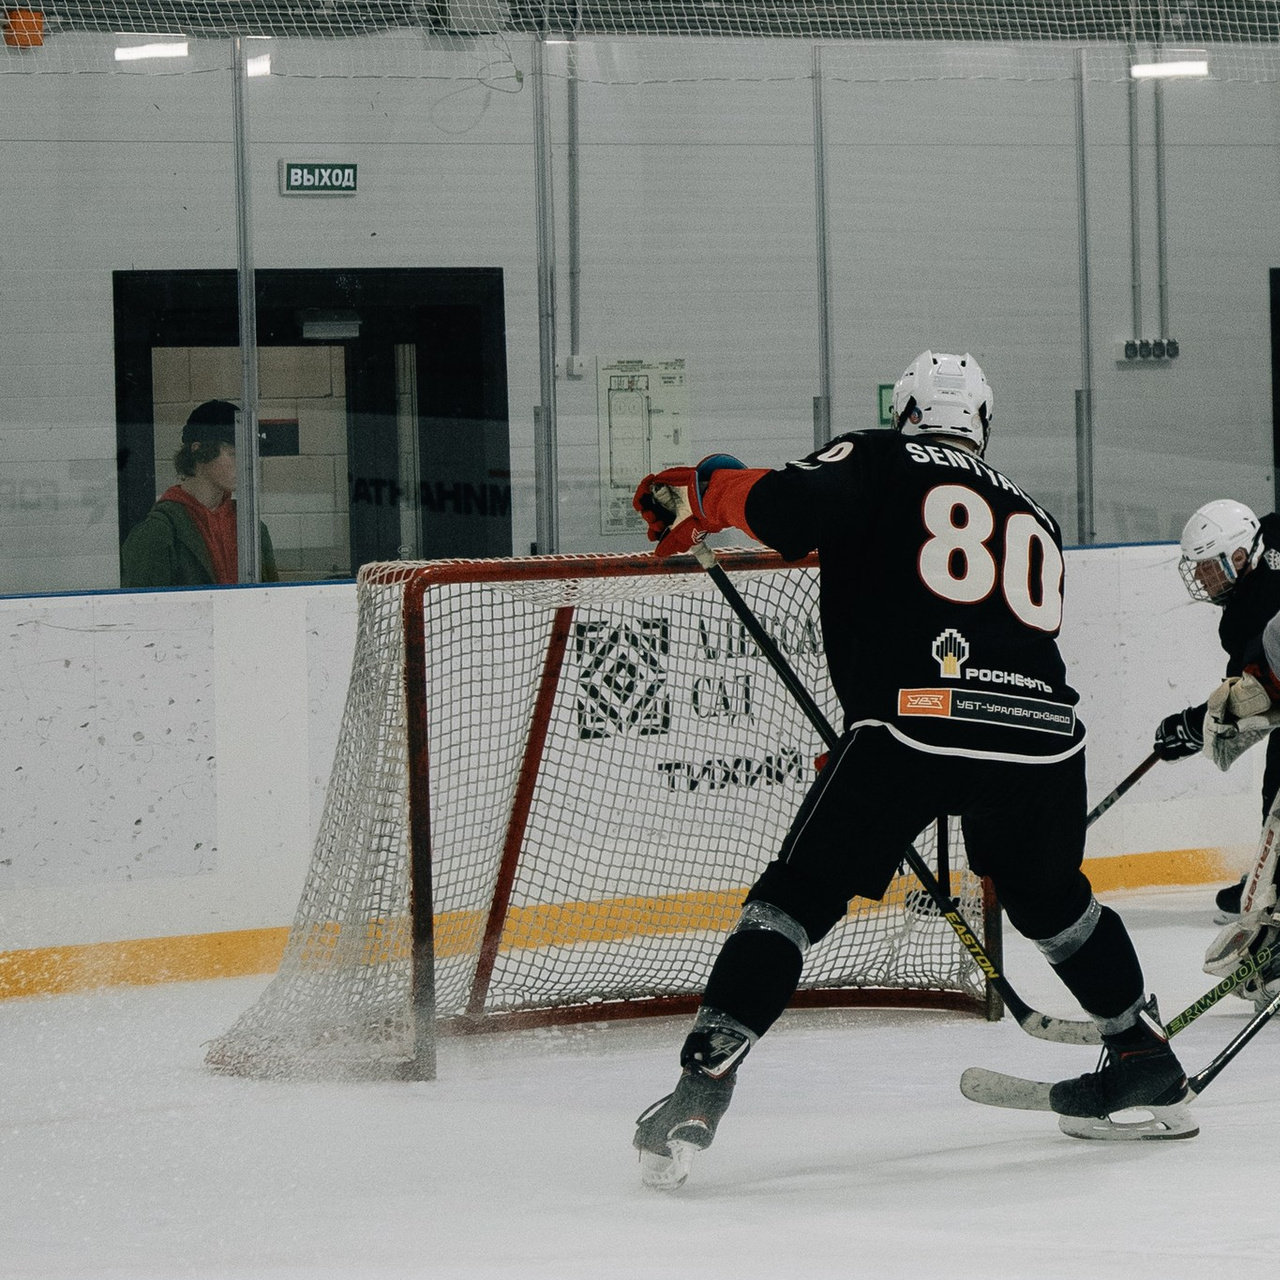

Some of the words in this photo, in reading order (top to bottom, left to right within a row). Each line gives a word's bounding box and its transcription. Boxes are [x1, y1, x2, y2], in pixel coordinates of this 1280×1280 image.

[290, 168, 355, 188] ВЫХОД
[917, 482, 1066, 633] 80
[692, 675, 755, 726] САД
[965, 668, 1054, 694] РОСНЕФТЬ
[945, 912, 1000, 979] EASTON
